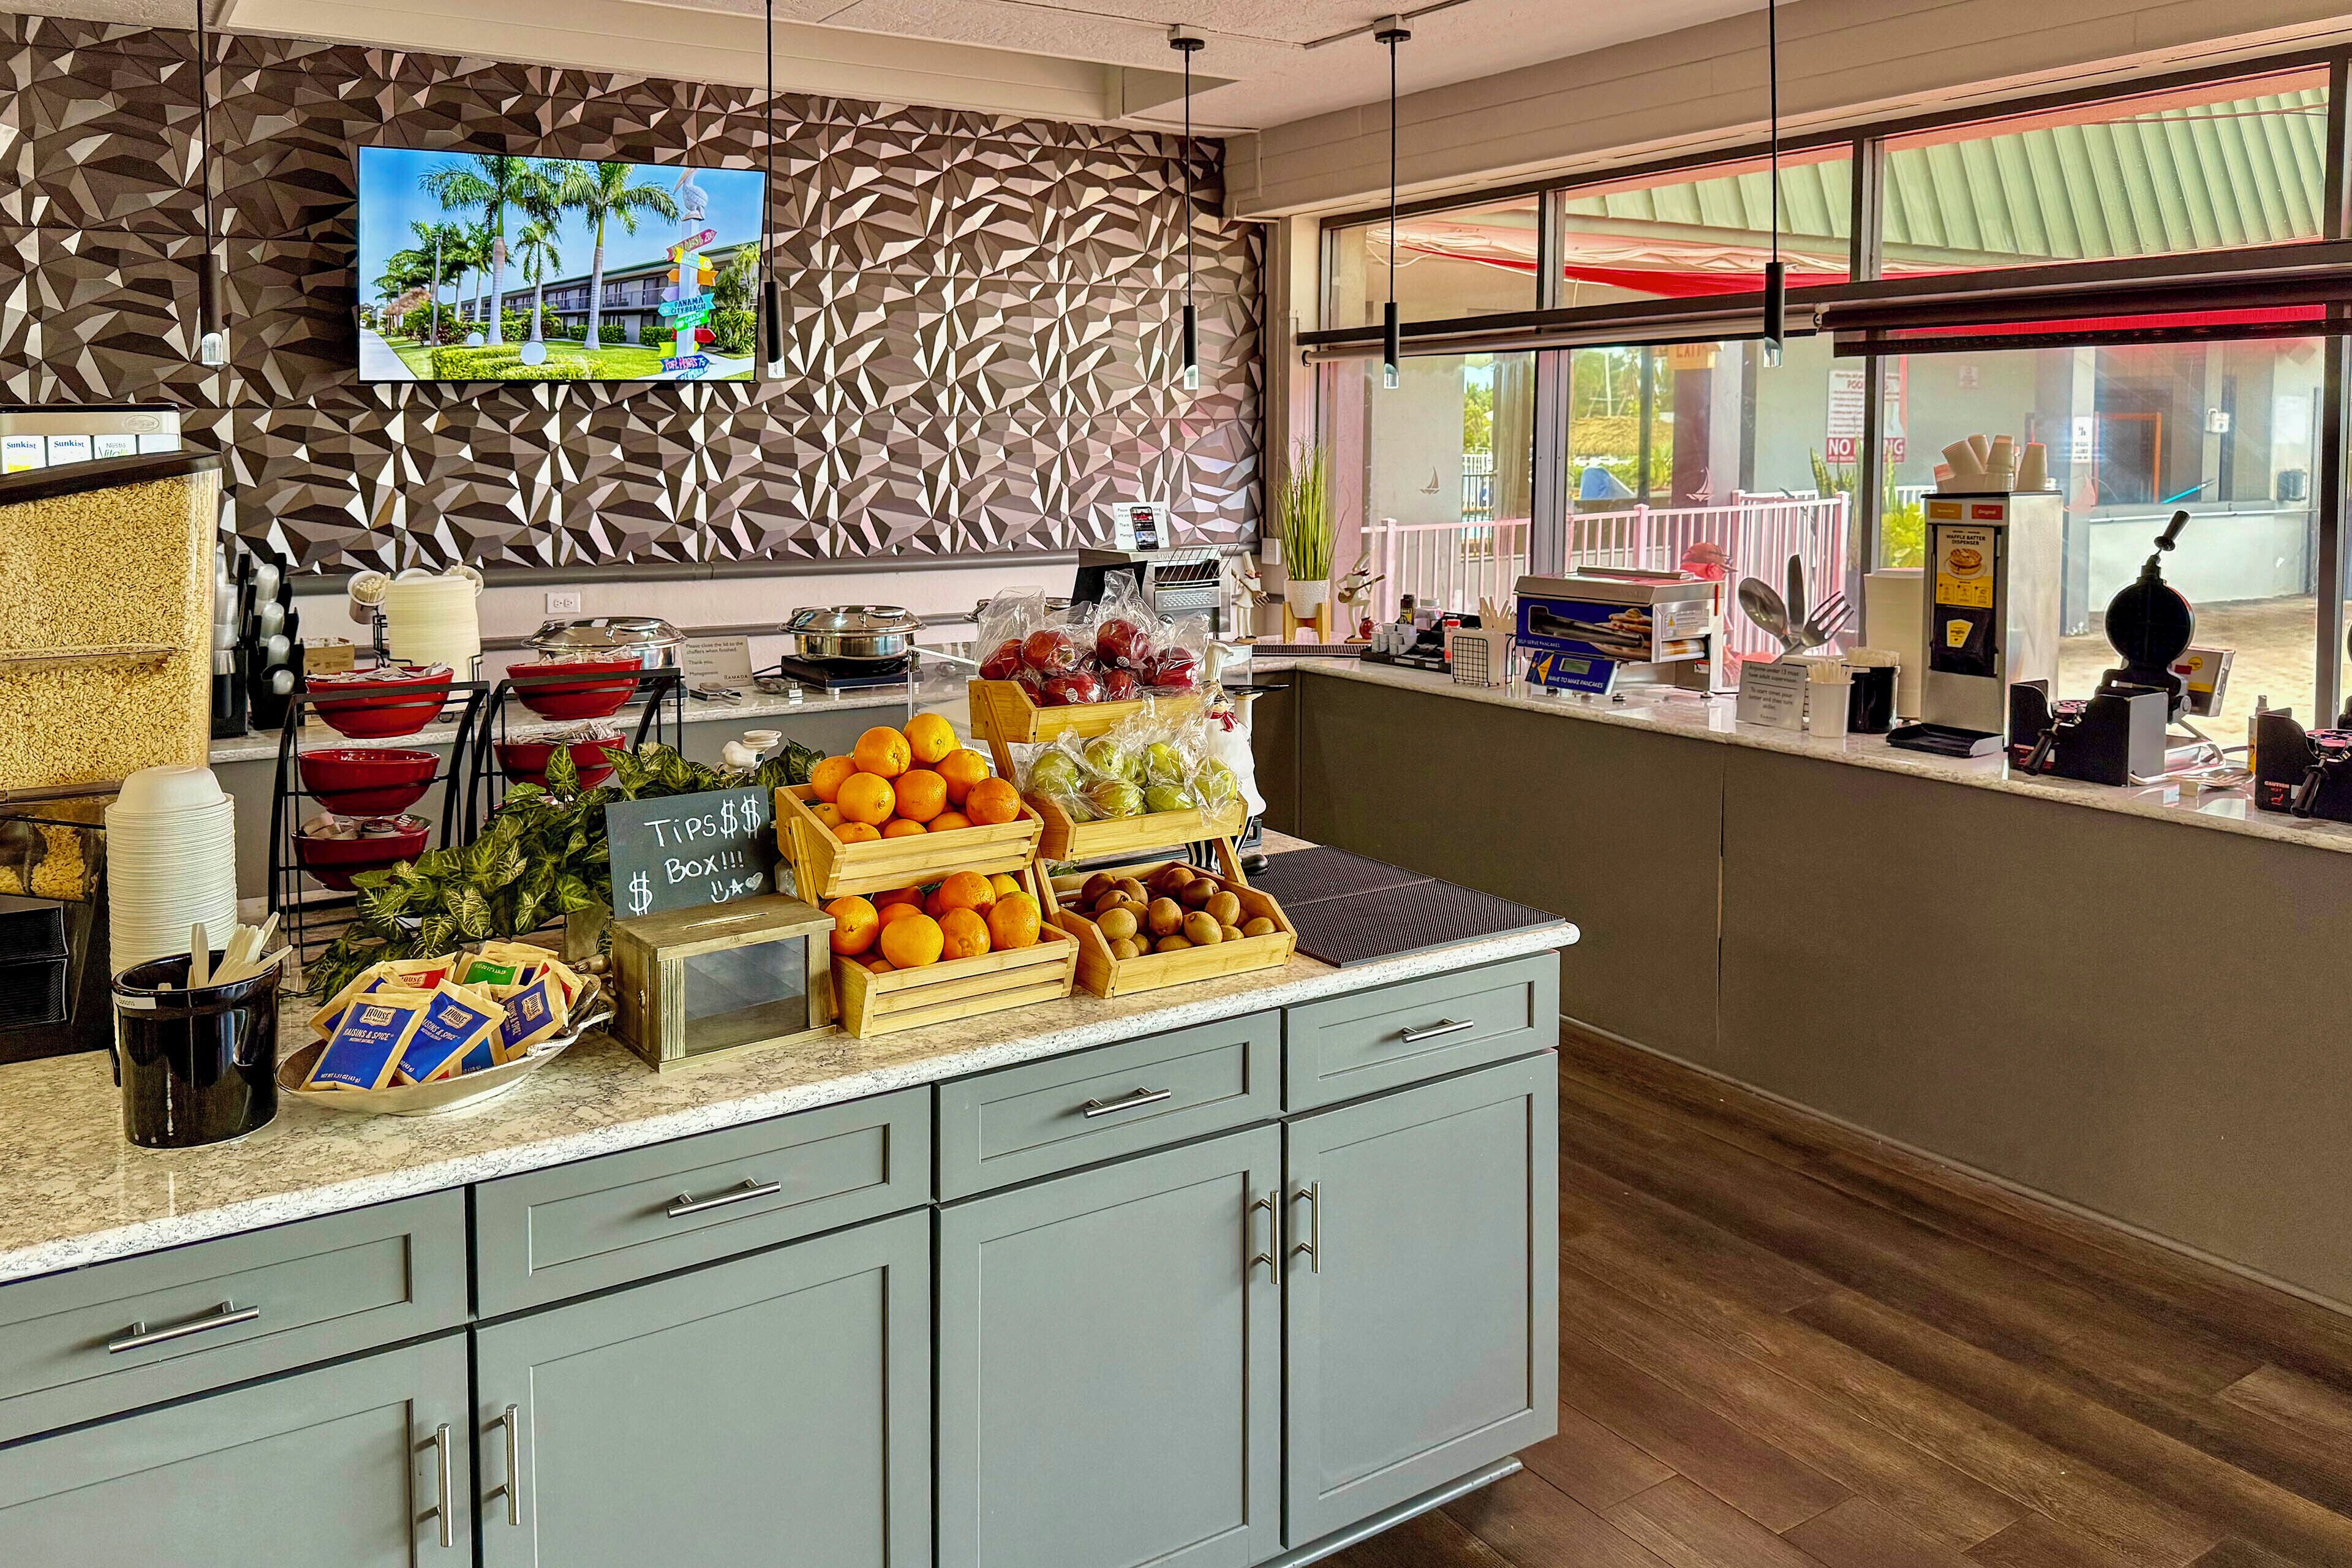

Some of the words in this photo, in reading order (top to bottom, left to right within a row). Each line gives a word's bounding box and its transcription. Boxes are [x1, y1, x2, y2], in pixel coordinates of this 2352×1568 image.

[675, 296, 704, 306] PANAMA
[685, 304, 706, 312] BEACH
[1827, 438, 1851, 456] NO
[1580, 679, 1604, 688] PANCAKES
[2264, 780, 2290, 789] CAUTION
[628, 870, 653, 916] $
[527, 994, 540, 1016] HOUSE
[366, 1008, 392, 1020] HOUSE
[445, 1009, 469, 1024] HOUSE
[422, 1018, 439, 1033] AISINS
[342, 1028, 366, 1039] RAISINS
[372, 1031, 391, 1041] SPICE
